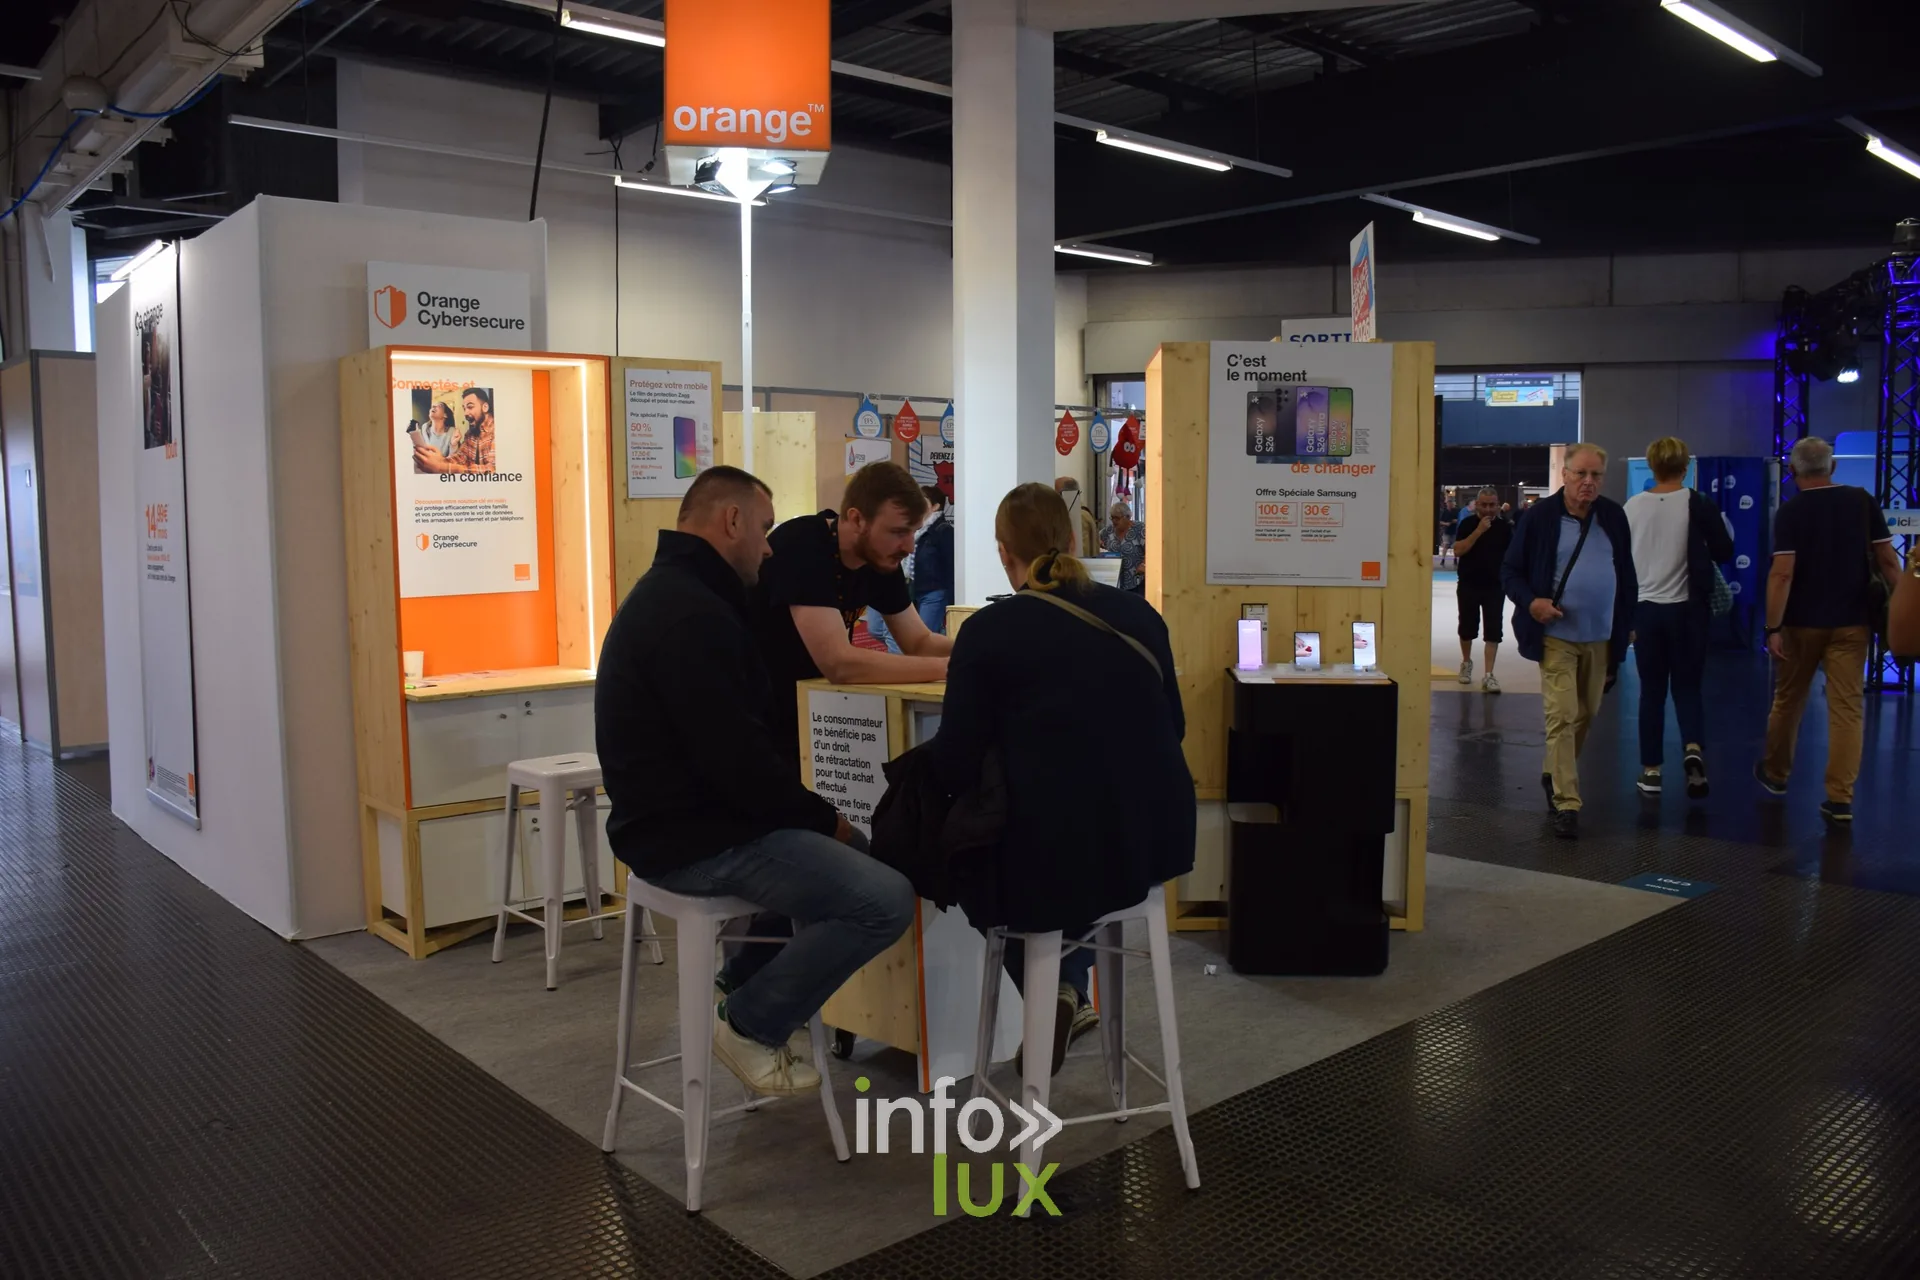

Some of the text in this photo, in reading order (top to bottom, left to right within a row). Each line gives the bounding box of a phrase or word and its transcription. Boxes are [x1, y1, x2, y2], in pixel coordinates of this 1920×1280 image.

[673, 105, 812, 143] orange
[417, 291, 480, 313] Orange
[418, 309, 525, 330] Cybersecure
[1227, 354, 1267, 367] C'est
[1226, 368, 1307, 382] le moment
[462, 380, 475, 390] et
[629, 380, 708, 390] Protégez votre mobile
[1254, 418, 1266, 452] Galaxy
[1306, 418, 1317, 453] Galaxy
[1317, 412, 1326, 453] S26 Ultra
[1330, 420, 1338, 452] Galaxy
[1265, 436, 1274, 452] S26
[1290, 460, 1376, 477] de changer
[439, 470, 523, 482] en confiance
[1255, 488, 1357, 498] Offre Spéciale Samsung
[1258, 504, 1289, 515] 100 €
[1304, 505, 1331, 516] 30 €
[1897, 516, 1911, 527] ici
[433, 534, 459, 542] Orange
[433, 541, 478, 549] Cybersecure
[812, 712, 883, 728] Le consommateur
[813, 727, 876, 743] ne bénéficie pas
[814, 740, 850, 753] d'un droit
[815, 753, 871, 769] de rétractation
[815, 768, 874, 783] pour tout achat
[816, 781, 847, 793] effectué
[820, 794, 871, 810] ans une foire
[850, 813, 860, 823] un
[861, 814, 872, 825] sa
